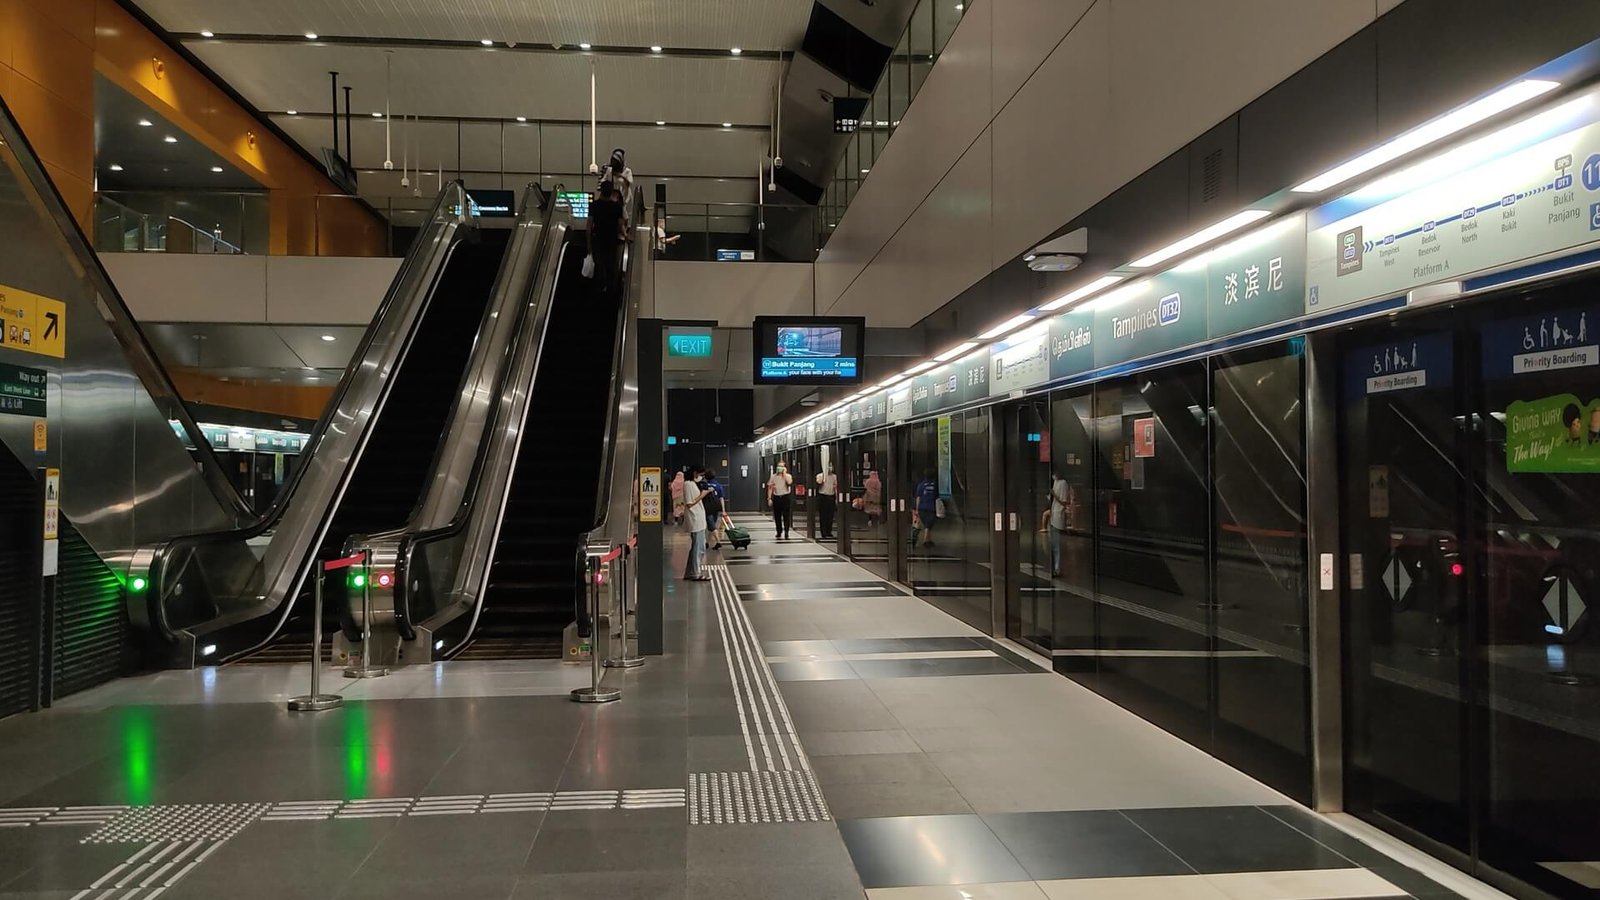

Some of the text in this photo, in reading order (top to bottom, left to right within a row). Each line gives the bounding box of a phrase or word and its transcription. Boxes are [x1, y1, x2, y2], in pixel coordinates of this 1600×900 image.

[1553, 192, 1575, 206] Bukit
[1502, 208, 1516, 220] Kaki
[1548, 208, 1581, 224] Panjang
[1461, 220, 1479, 233] Bedok
[1501, 221, 1517, 233] Bukit
[1421, 233, 1438, 245] Bedok
[1461, 233, 1479, 244] North
[1379, 246, 1400, 258] Tampines
[1418, 245, 1441, 257] Reservoir
[1413, 259, 1451, 278] Platform A
[1224, 256, 1284, 305] 淡滨尼
[1112, 301, 1178, 339] Tampines DT32
[681, 339, 707, 353] EXIT
[772, 361, 788, 369] Bukit
[790, 361, 815, 370] Panjang
[1523, 352, 1587, 369] Priority Boarding
[19, 371, 40, 384] Way out
[789, 369, 800, 377] your
[823, 369, 834, 377] your
[1373, 375, 1418, 391] Priority Boarding
[14, 399, 23, 409] Lift
[1513, 436, 1555, 464] The Way!
